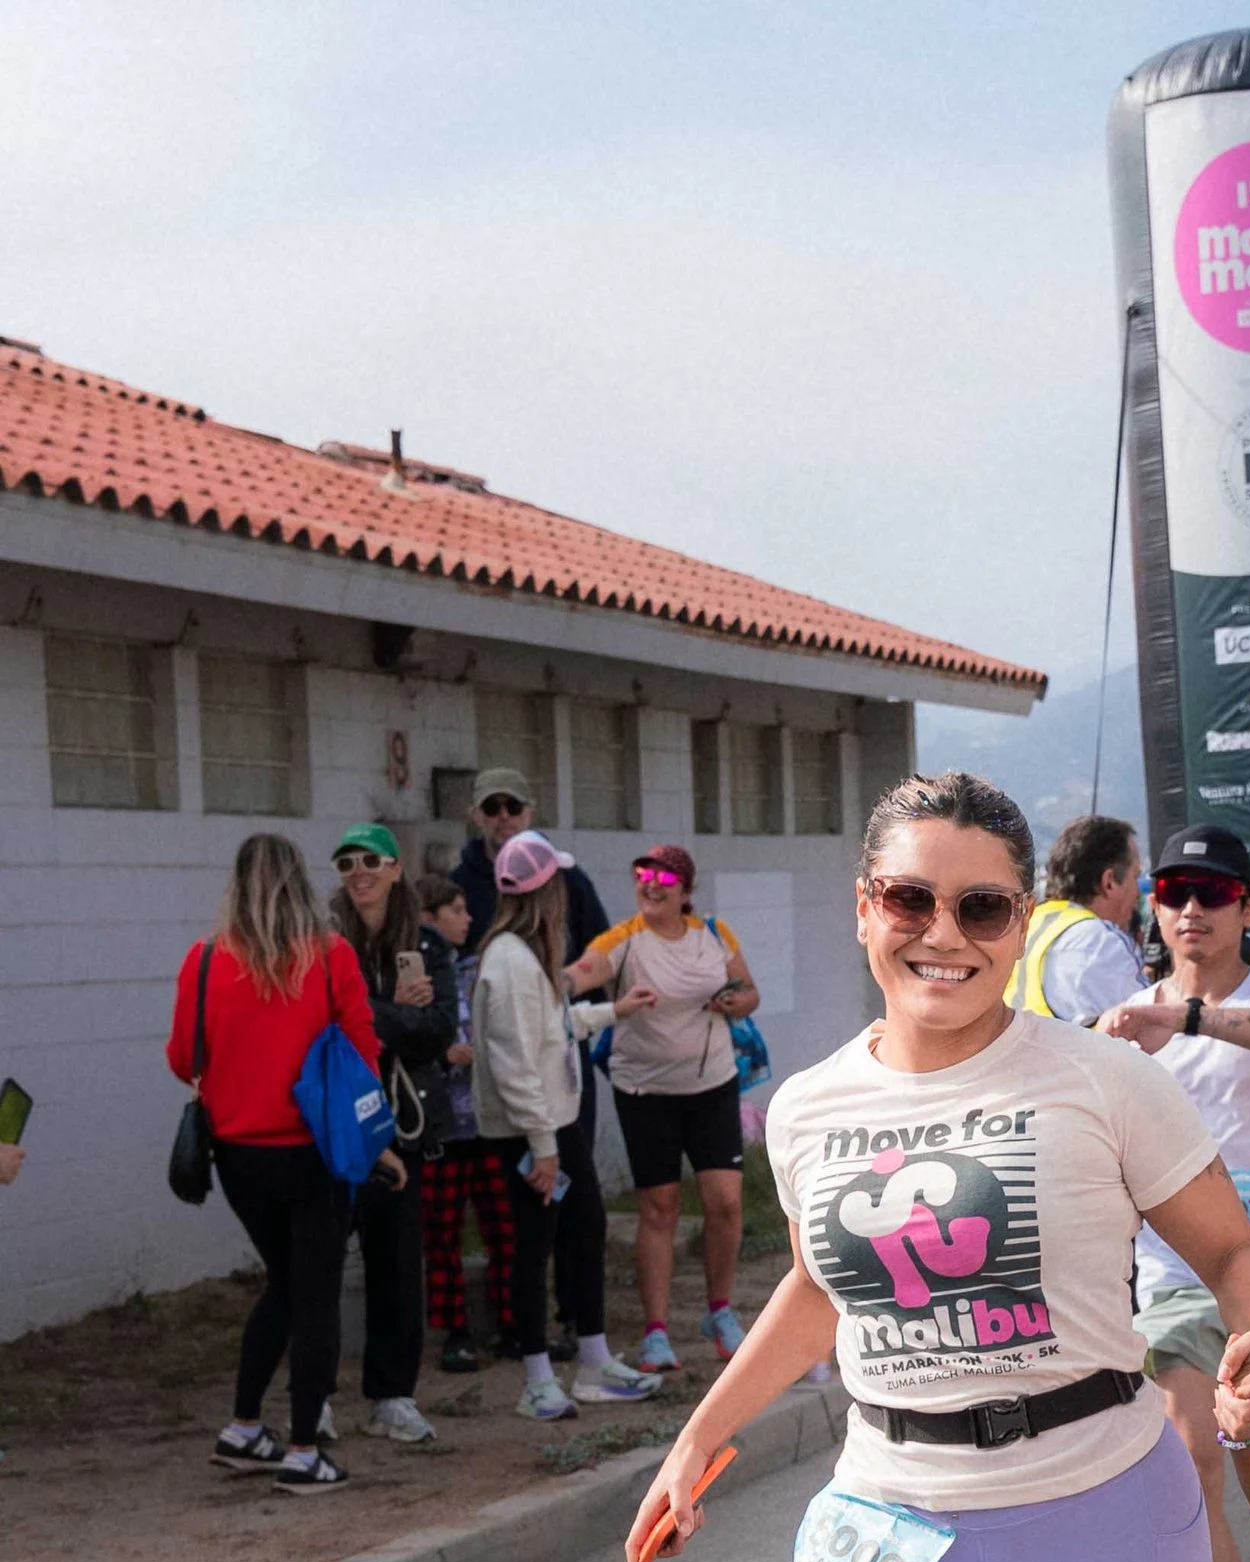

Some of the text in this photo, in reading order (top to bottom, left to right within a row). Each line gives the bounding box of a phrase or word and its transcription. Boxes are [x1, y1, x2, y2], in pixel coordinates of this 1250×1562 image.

[823, 1108, 1036, 1163] move for
[854, 1298, 1053, 1354] malibu
[862, 1363, 889, 1377] HALF
[1039, 1343, 1061, 1359] 5K
[886, 1379, 917, 1391] ZUMA
